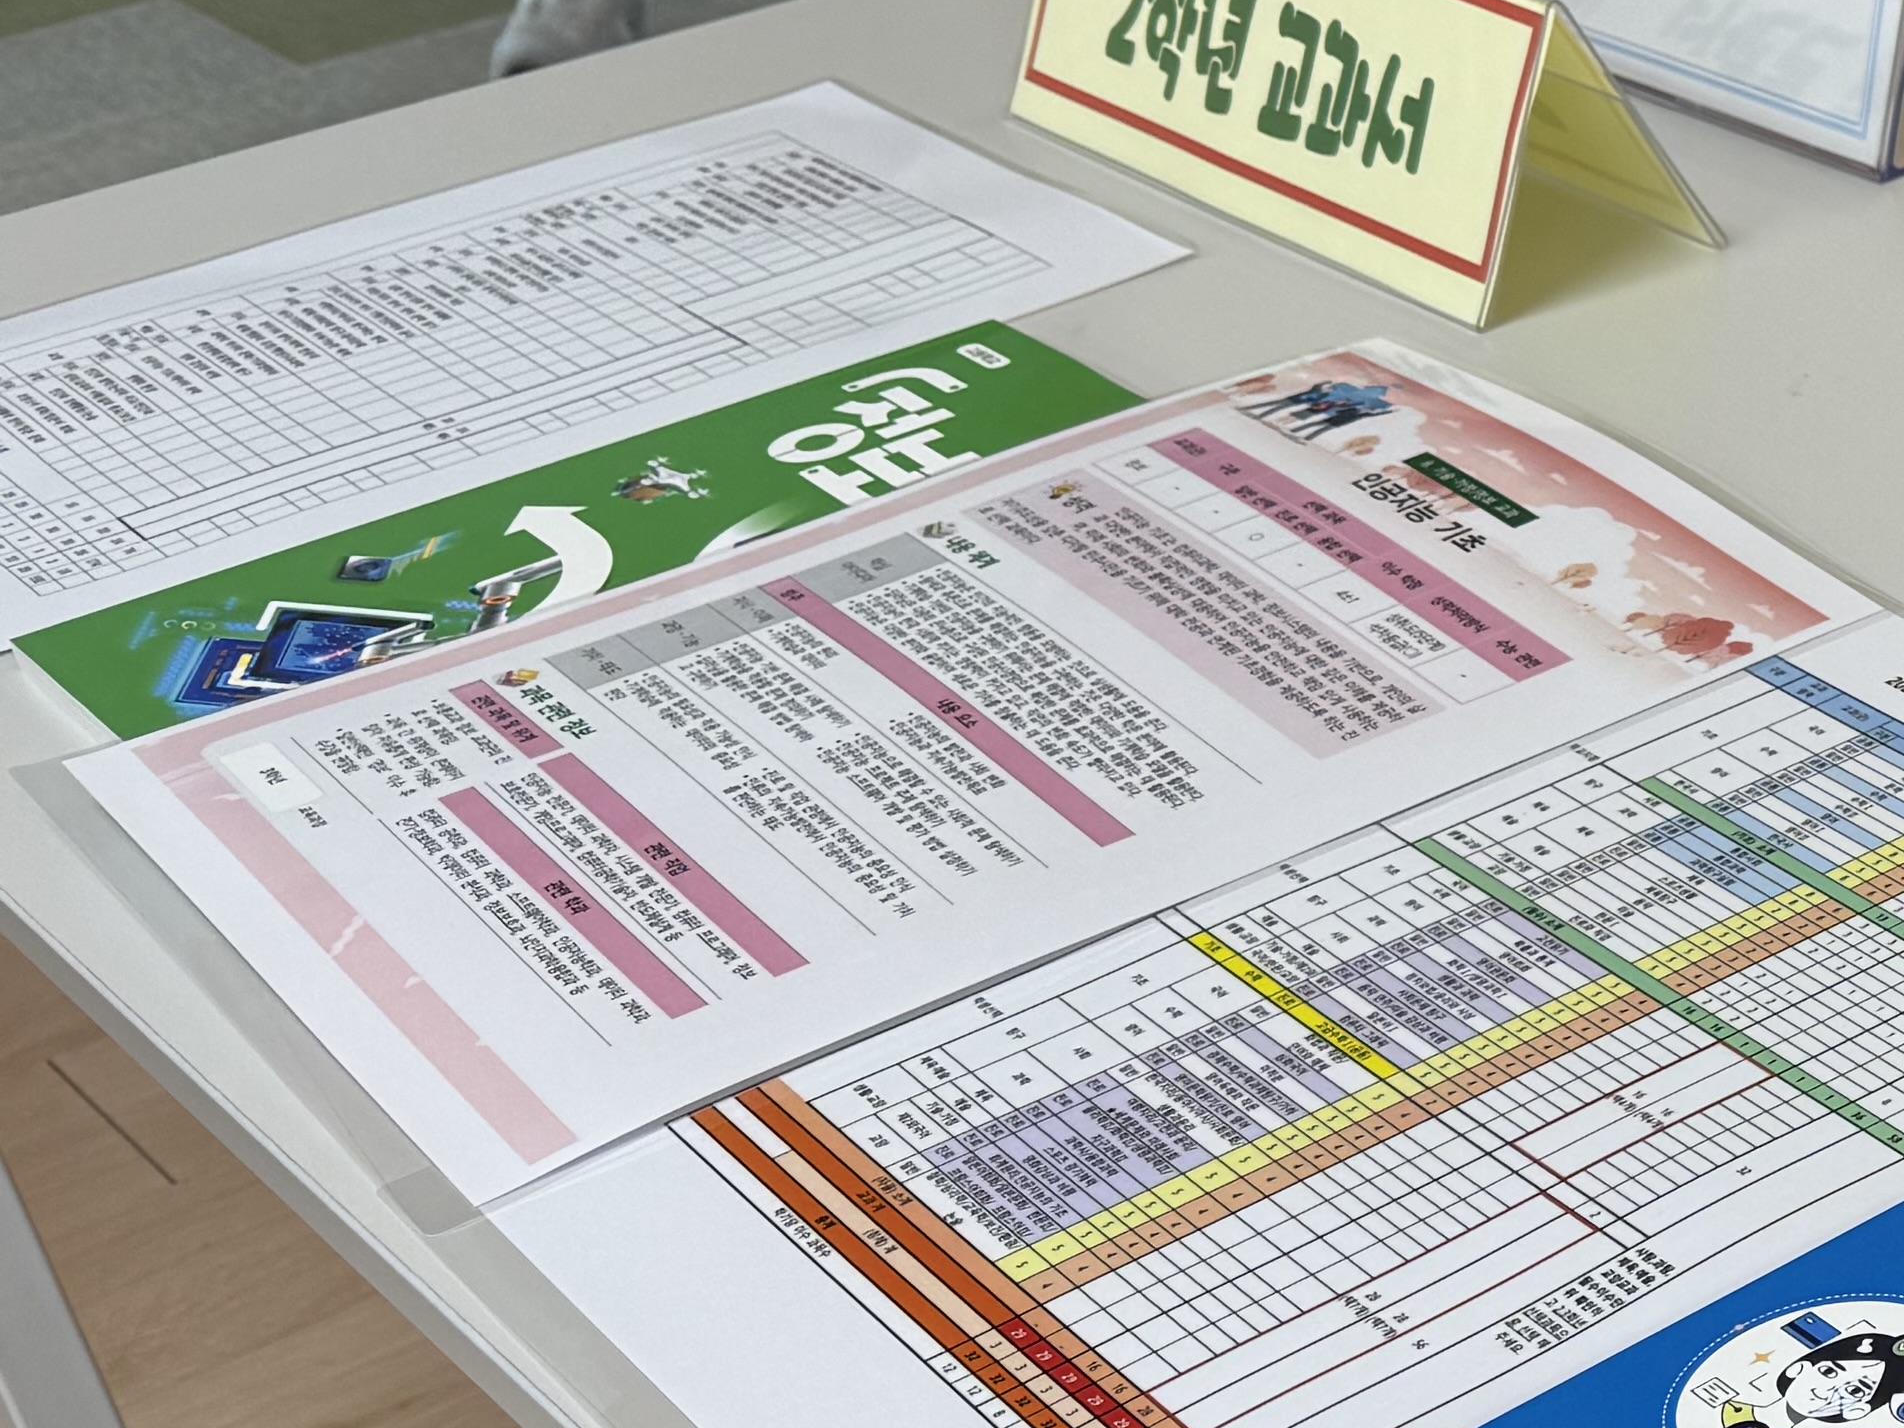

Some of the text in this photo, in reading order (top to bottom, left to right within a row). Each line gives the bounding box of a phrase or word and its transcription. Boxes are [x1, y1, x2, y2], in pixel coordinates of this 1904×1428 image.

[1257, 1, 1435, 175] 교과서
[1350, 472, 1487, 553] 인공지능 기초
[642, 841, 691, 877] 관련 직업
[542, 879, 591, 916] 관련 학과
